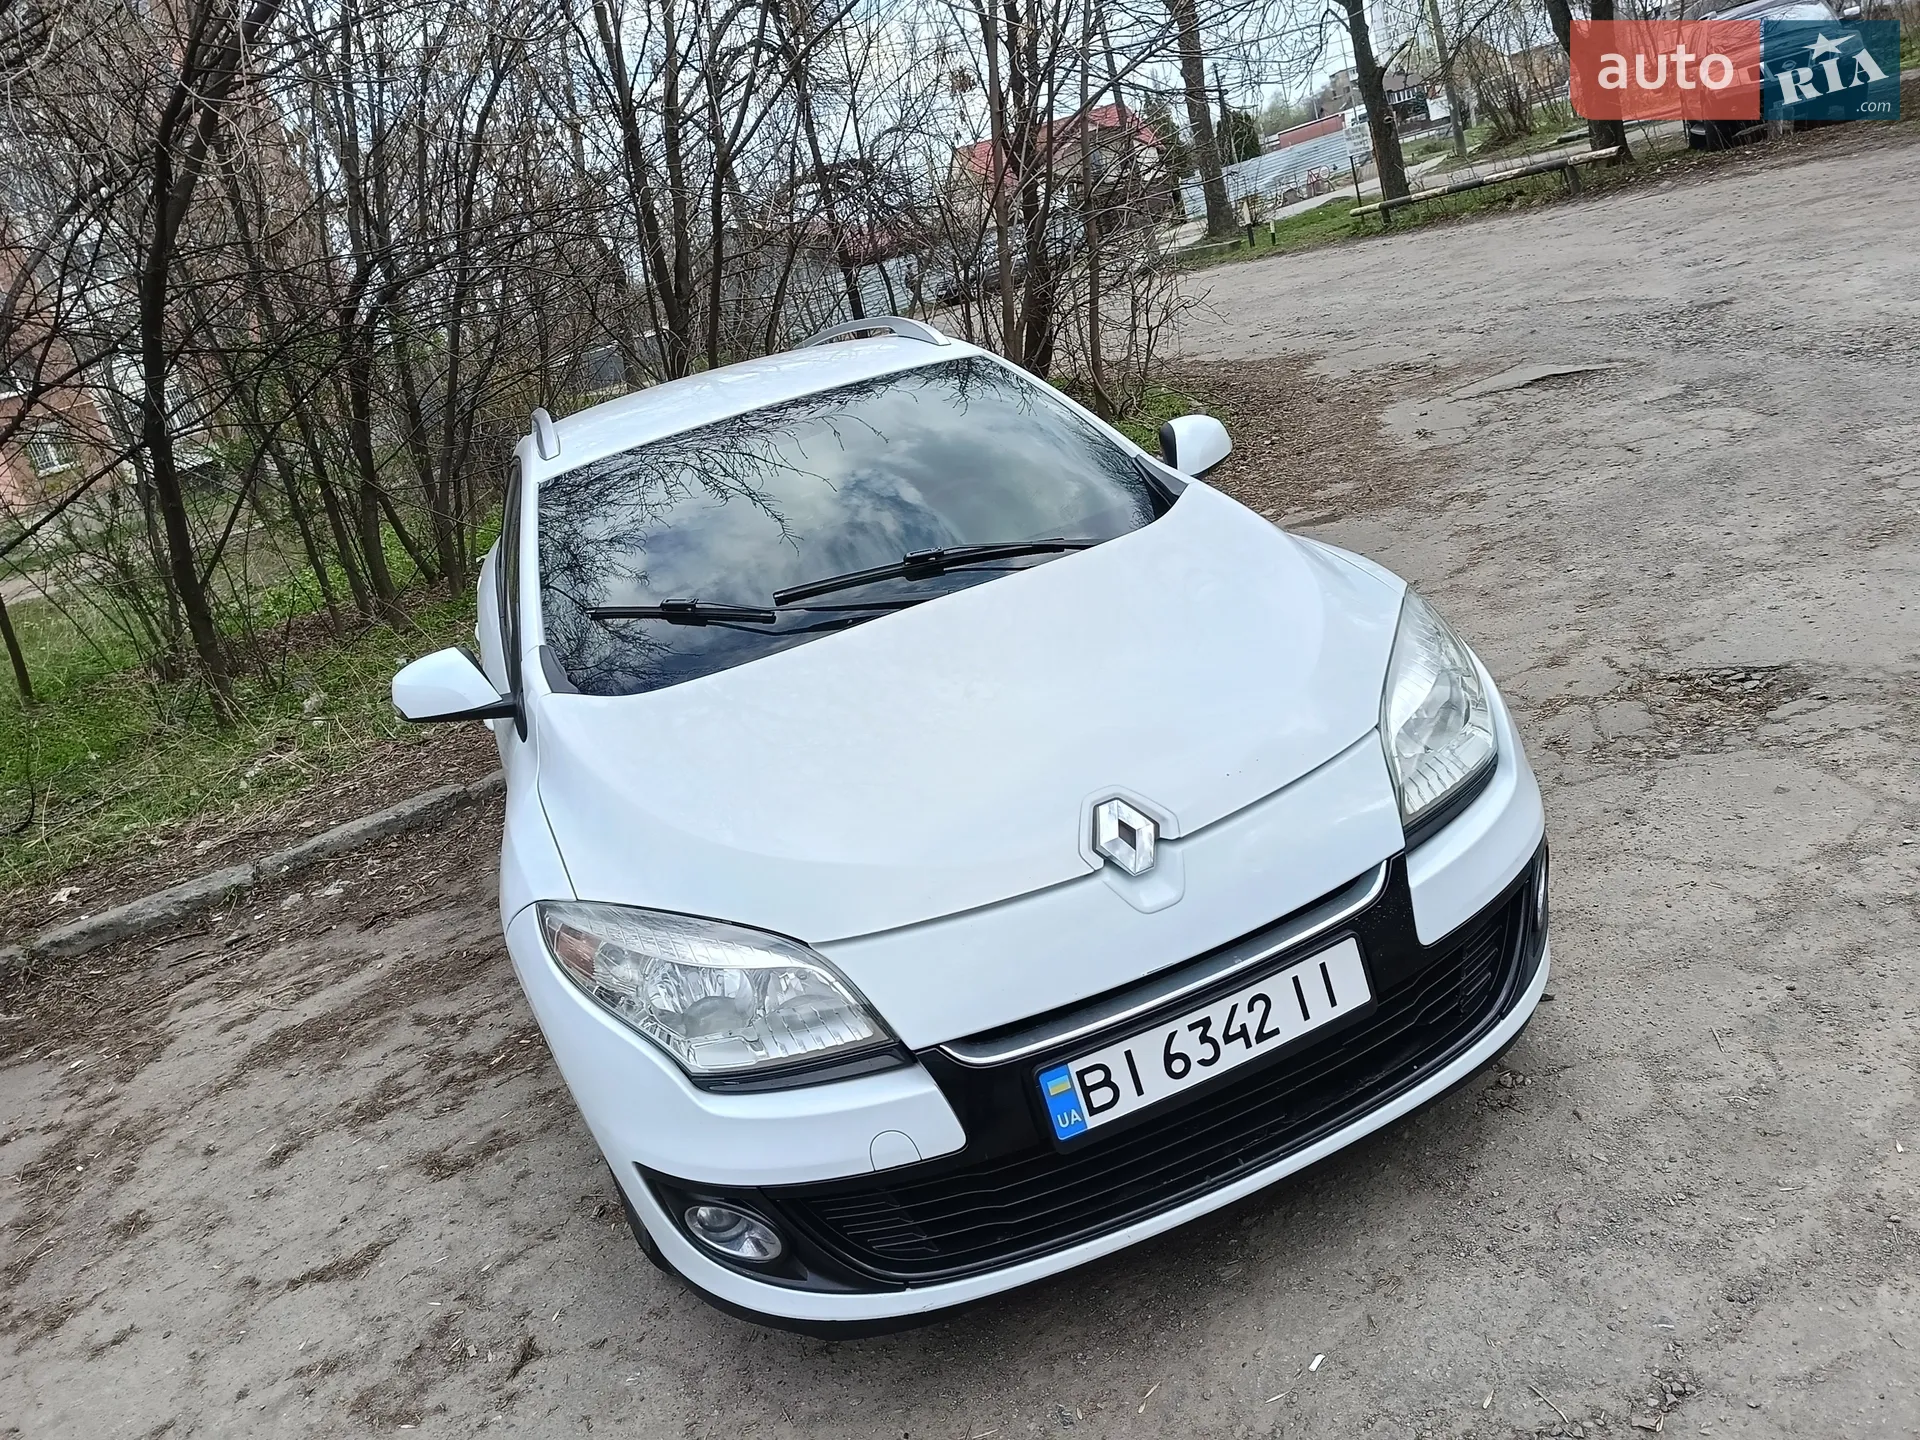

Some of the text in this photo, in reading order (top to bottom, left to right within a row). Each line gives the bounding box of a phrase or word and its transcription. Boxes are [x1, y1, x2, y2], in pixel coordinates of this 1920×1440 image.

[1075, 961, 1338, 1117] BI 6342 II
[1056, 1109, 1083, 1129] UA
